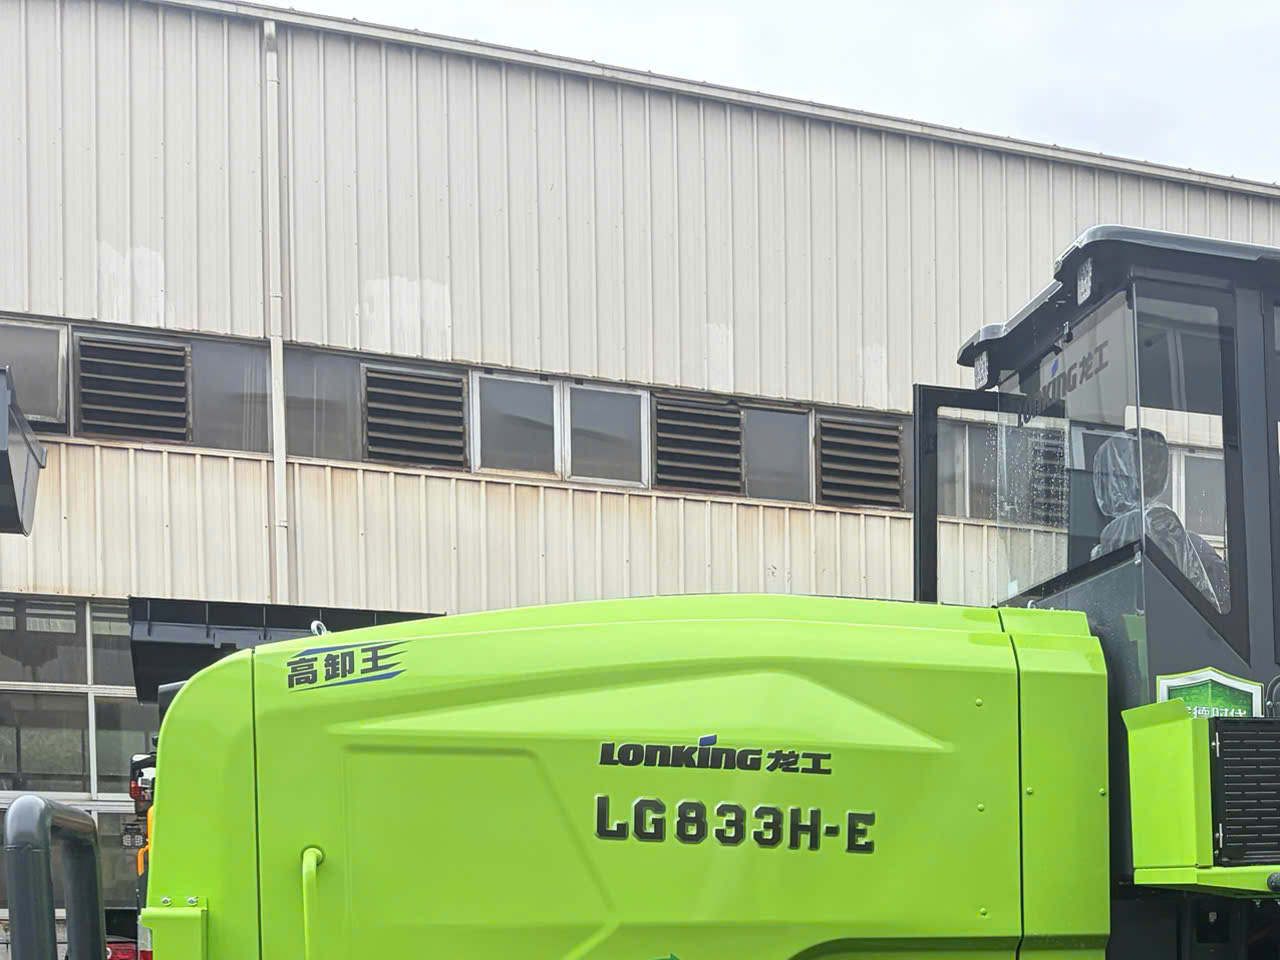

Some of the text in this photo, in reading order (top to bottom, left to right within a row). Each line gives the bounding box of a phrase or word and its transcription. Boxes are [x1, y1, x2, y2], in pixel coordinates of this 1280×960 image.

[287, 640, 409, 689] 高卸王
[1184, 705, 1247, 718] 德时代
[766, 750, 832, 775] 龙工
[594, 794, 876, 854] LG833H-E
